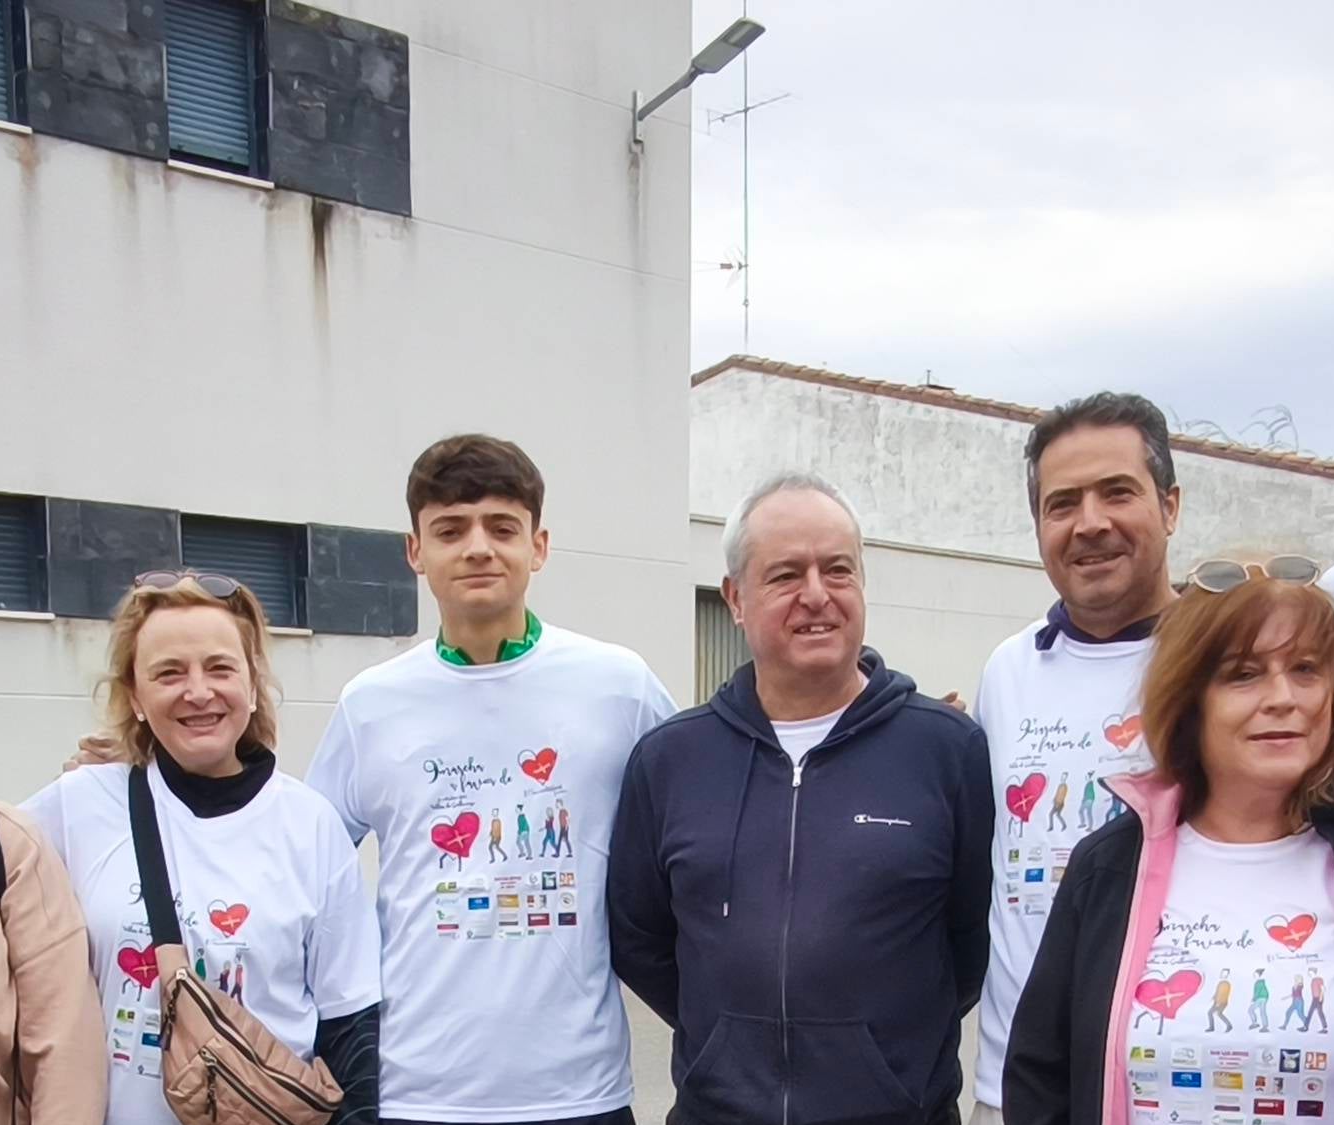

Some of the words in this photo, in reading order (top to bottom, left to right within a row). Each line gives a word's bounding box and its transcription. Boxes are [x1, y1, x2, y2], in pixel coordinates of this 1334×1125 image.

[1078, 731, 1092, 750] de
[499, 768, 512, 785] de
[1236, 929, 1255, 949] de
